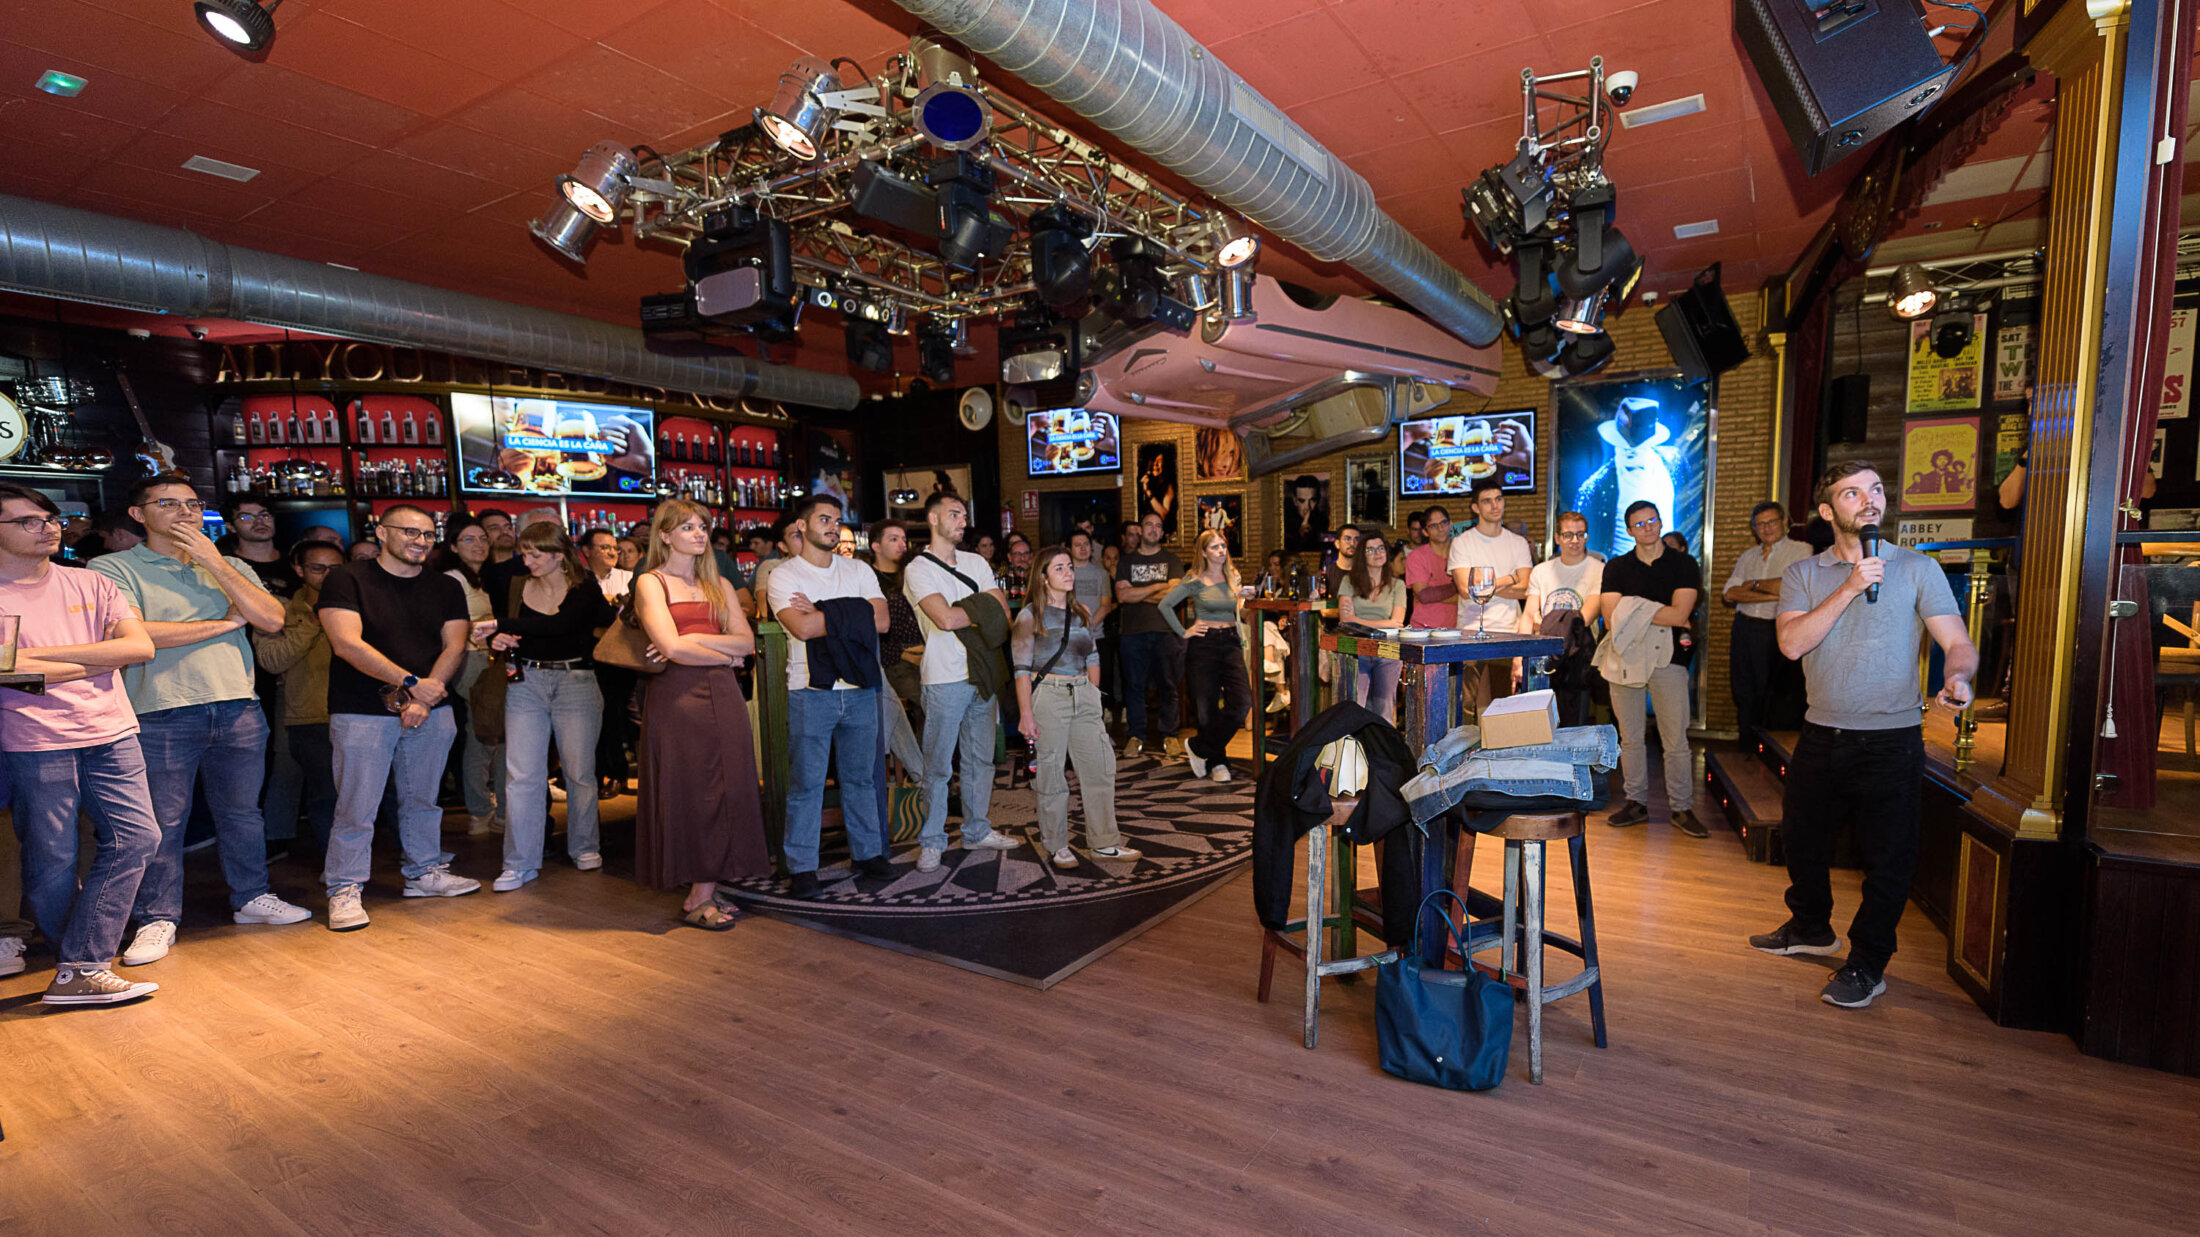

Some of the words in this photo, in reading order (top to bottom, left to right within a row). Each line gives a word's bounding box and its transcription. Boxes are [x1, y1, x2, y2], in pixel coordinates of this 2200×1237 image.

[508, 437, 520, 445] LA
[522, 438, 558, 448] CIENCIA
[559, 440, 570, 448] ES
[570, 440, 582, 449] LA
[583, 440, 609, 451] CAÑA
[1900, 523, 1943, 534] ABBEY
